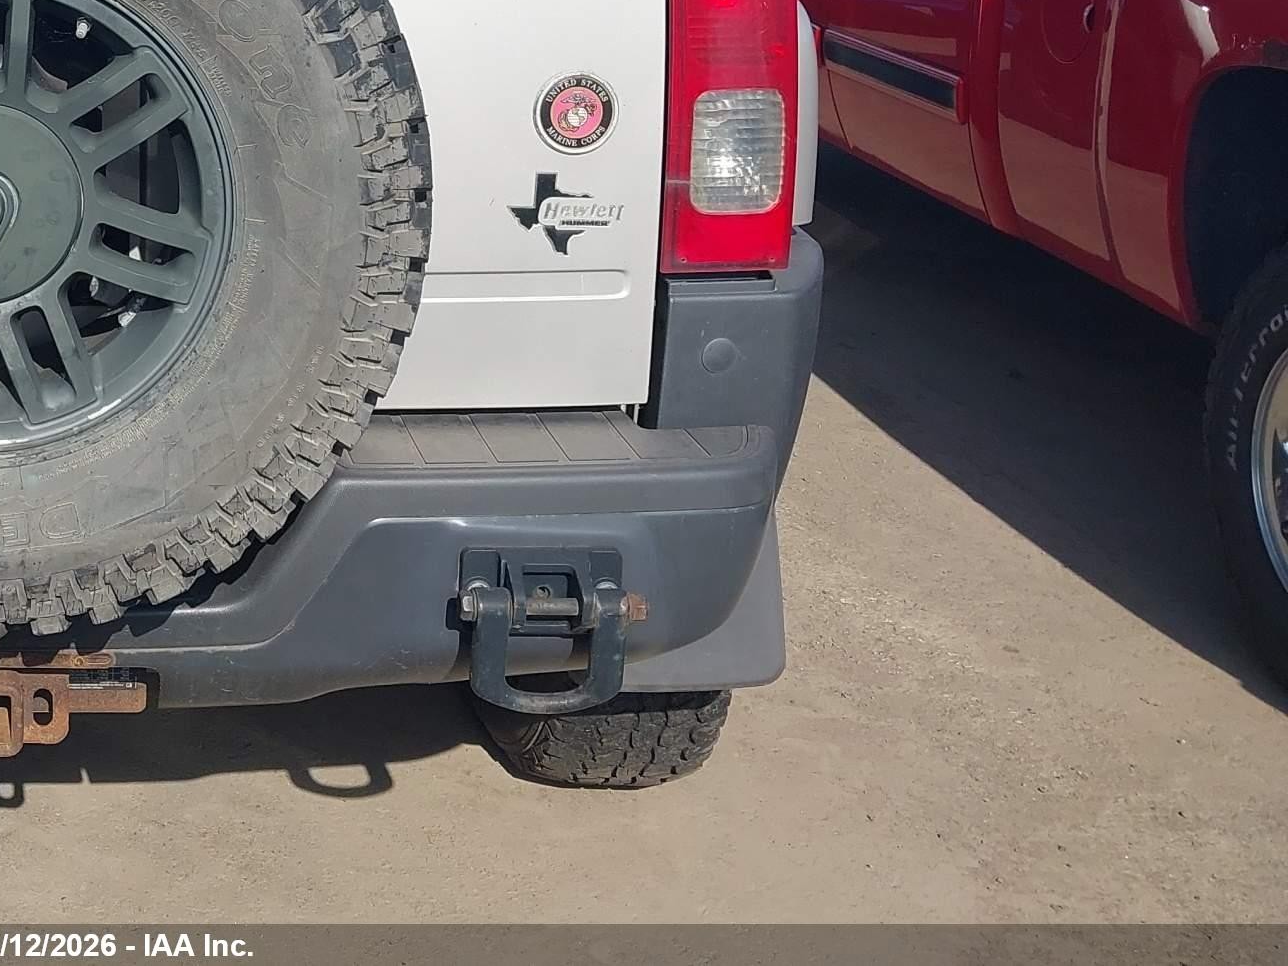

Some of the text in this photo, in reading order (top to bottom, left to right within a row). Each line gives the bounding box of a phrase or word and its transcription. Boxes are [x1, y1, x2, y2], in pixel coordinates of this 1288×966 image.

[545, 78, 609, 104] UNITED STATES
[546, 125, 607, 148] MARINE CORPS
[561, 219, 610, 227] HUMMER
